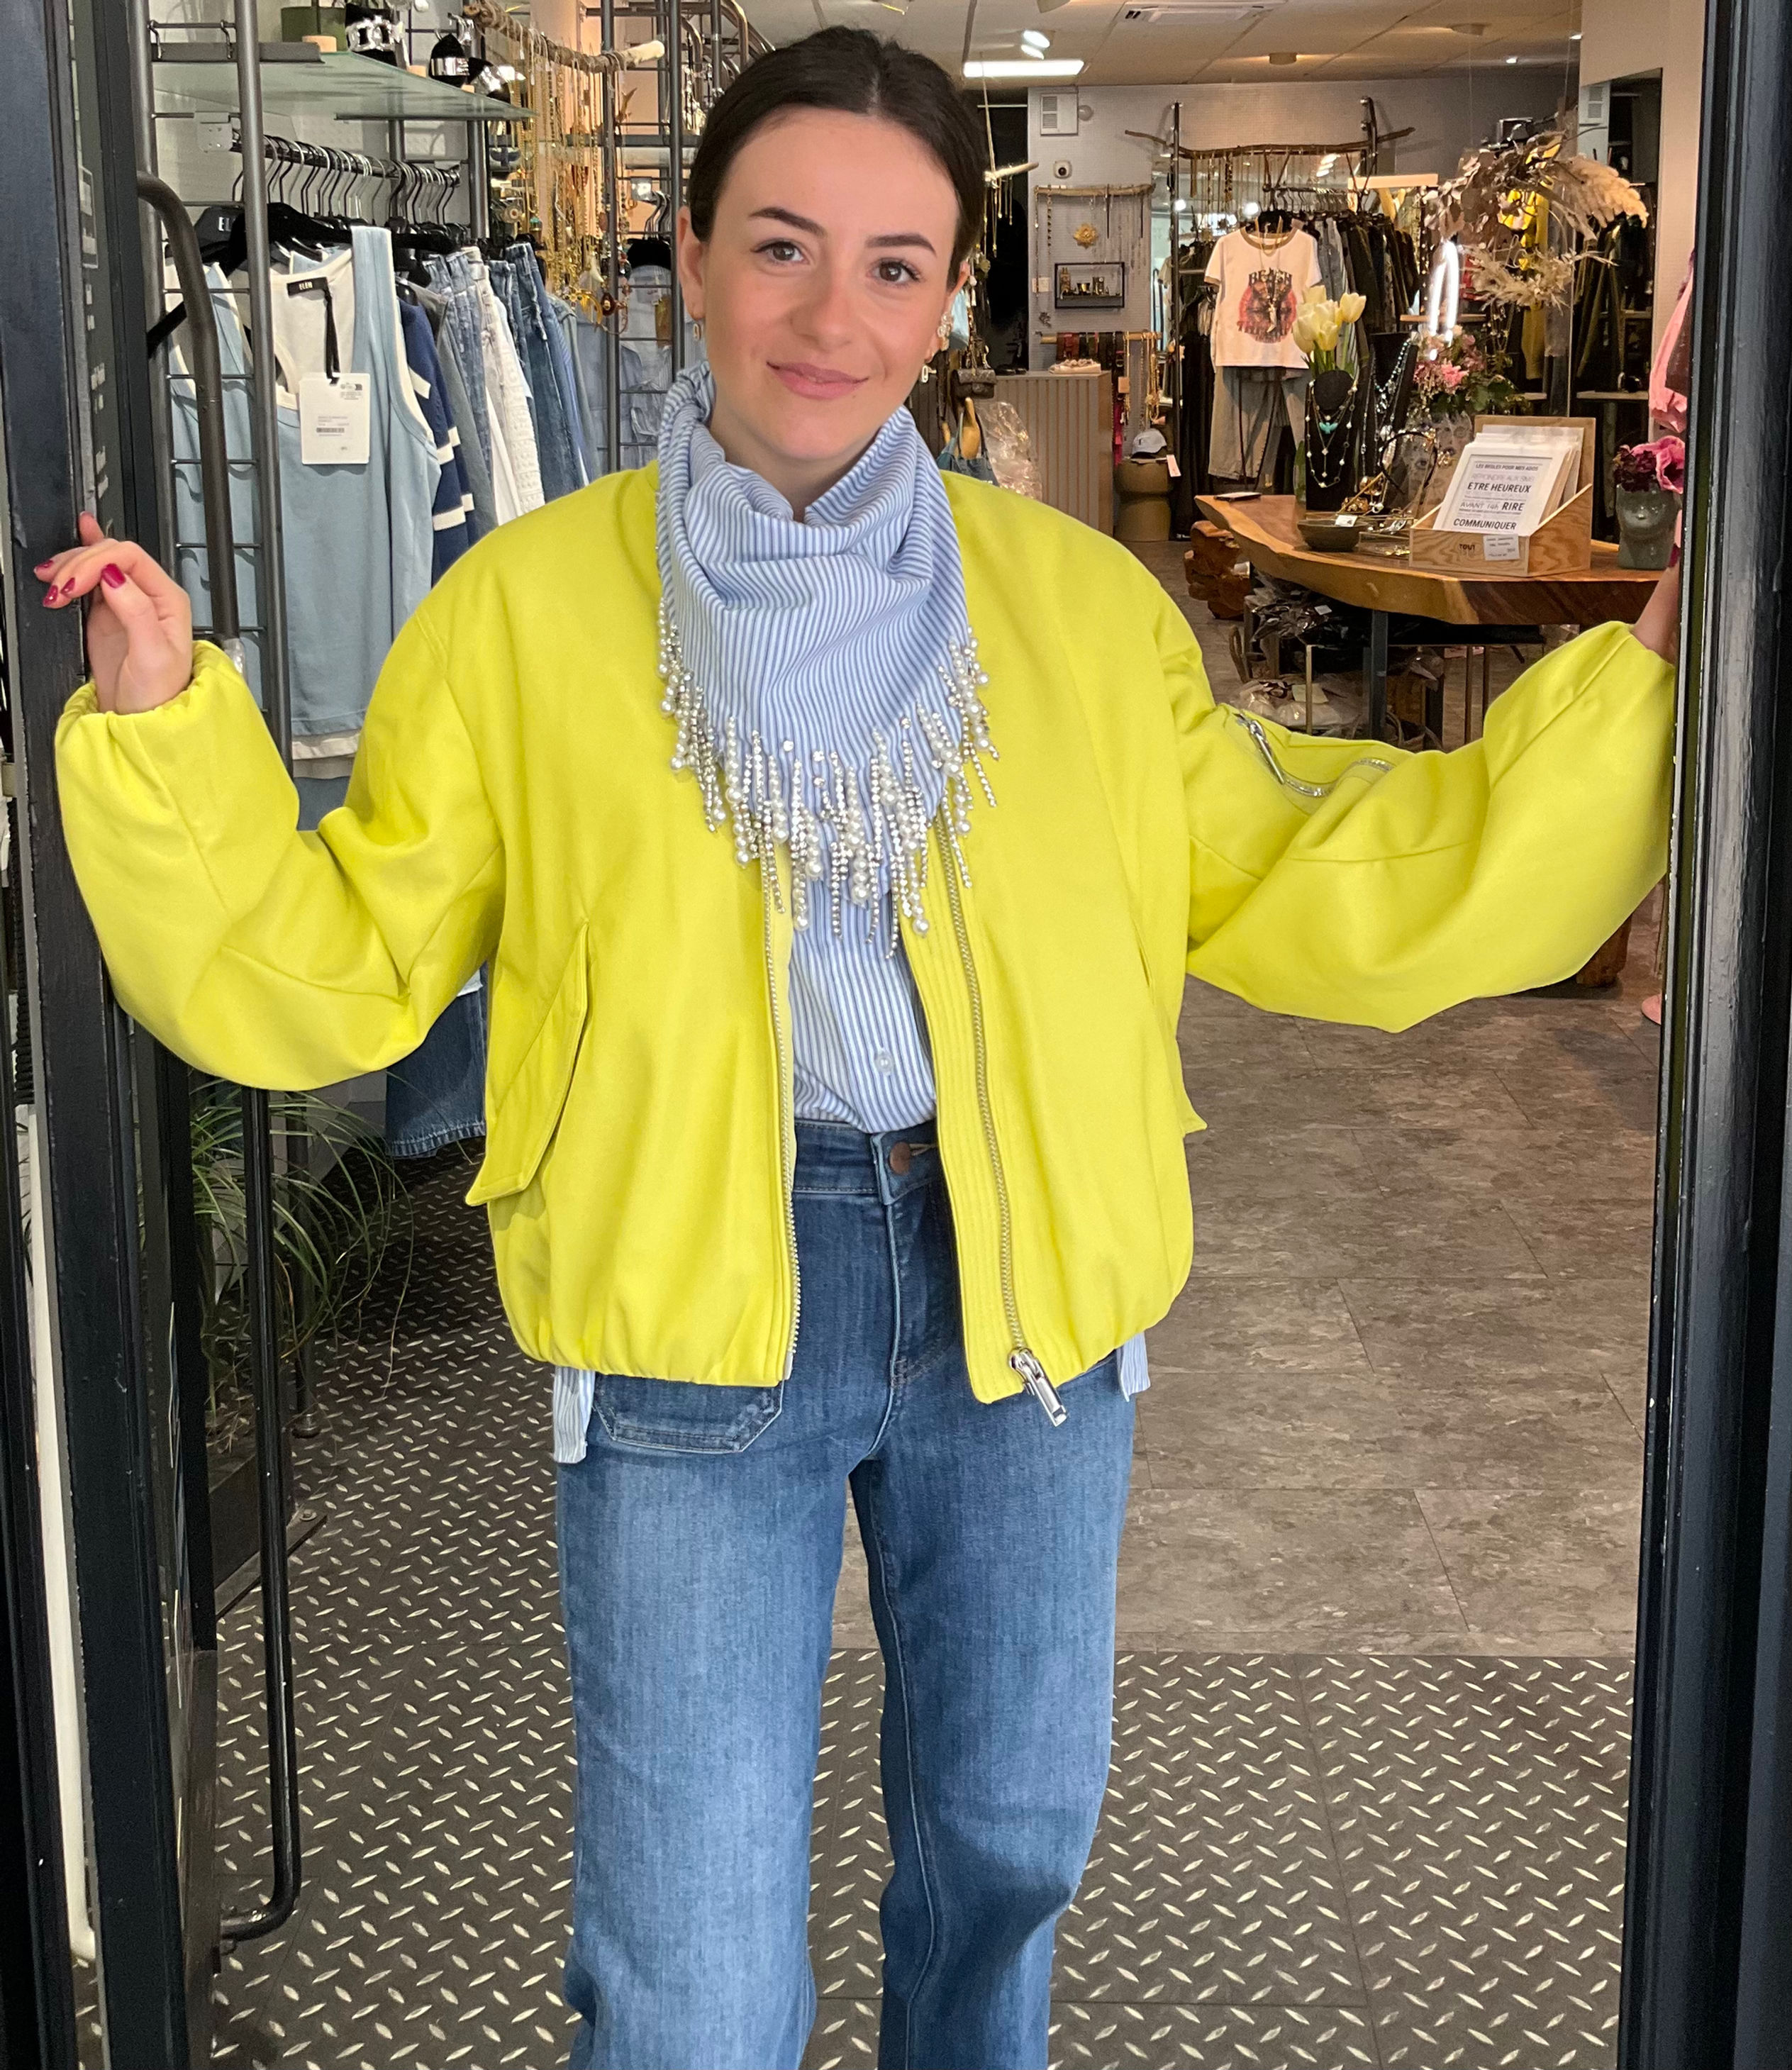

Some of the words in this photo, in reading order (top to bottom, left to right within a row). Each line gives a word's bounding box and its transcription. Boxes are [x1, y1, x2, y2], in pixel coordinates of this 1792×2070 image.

[1467, 482, 1490, 491] ETRE
[1491, 484, 1532, 493] HEUREUX
[1502, 502, 1525, 511] RIRE
[1454, 518, 1517, 530] COMMUNIQUER
